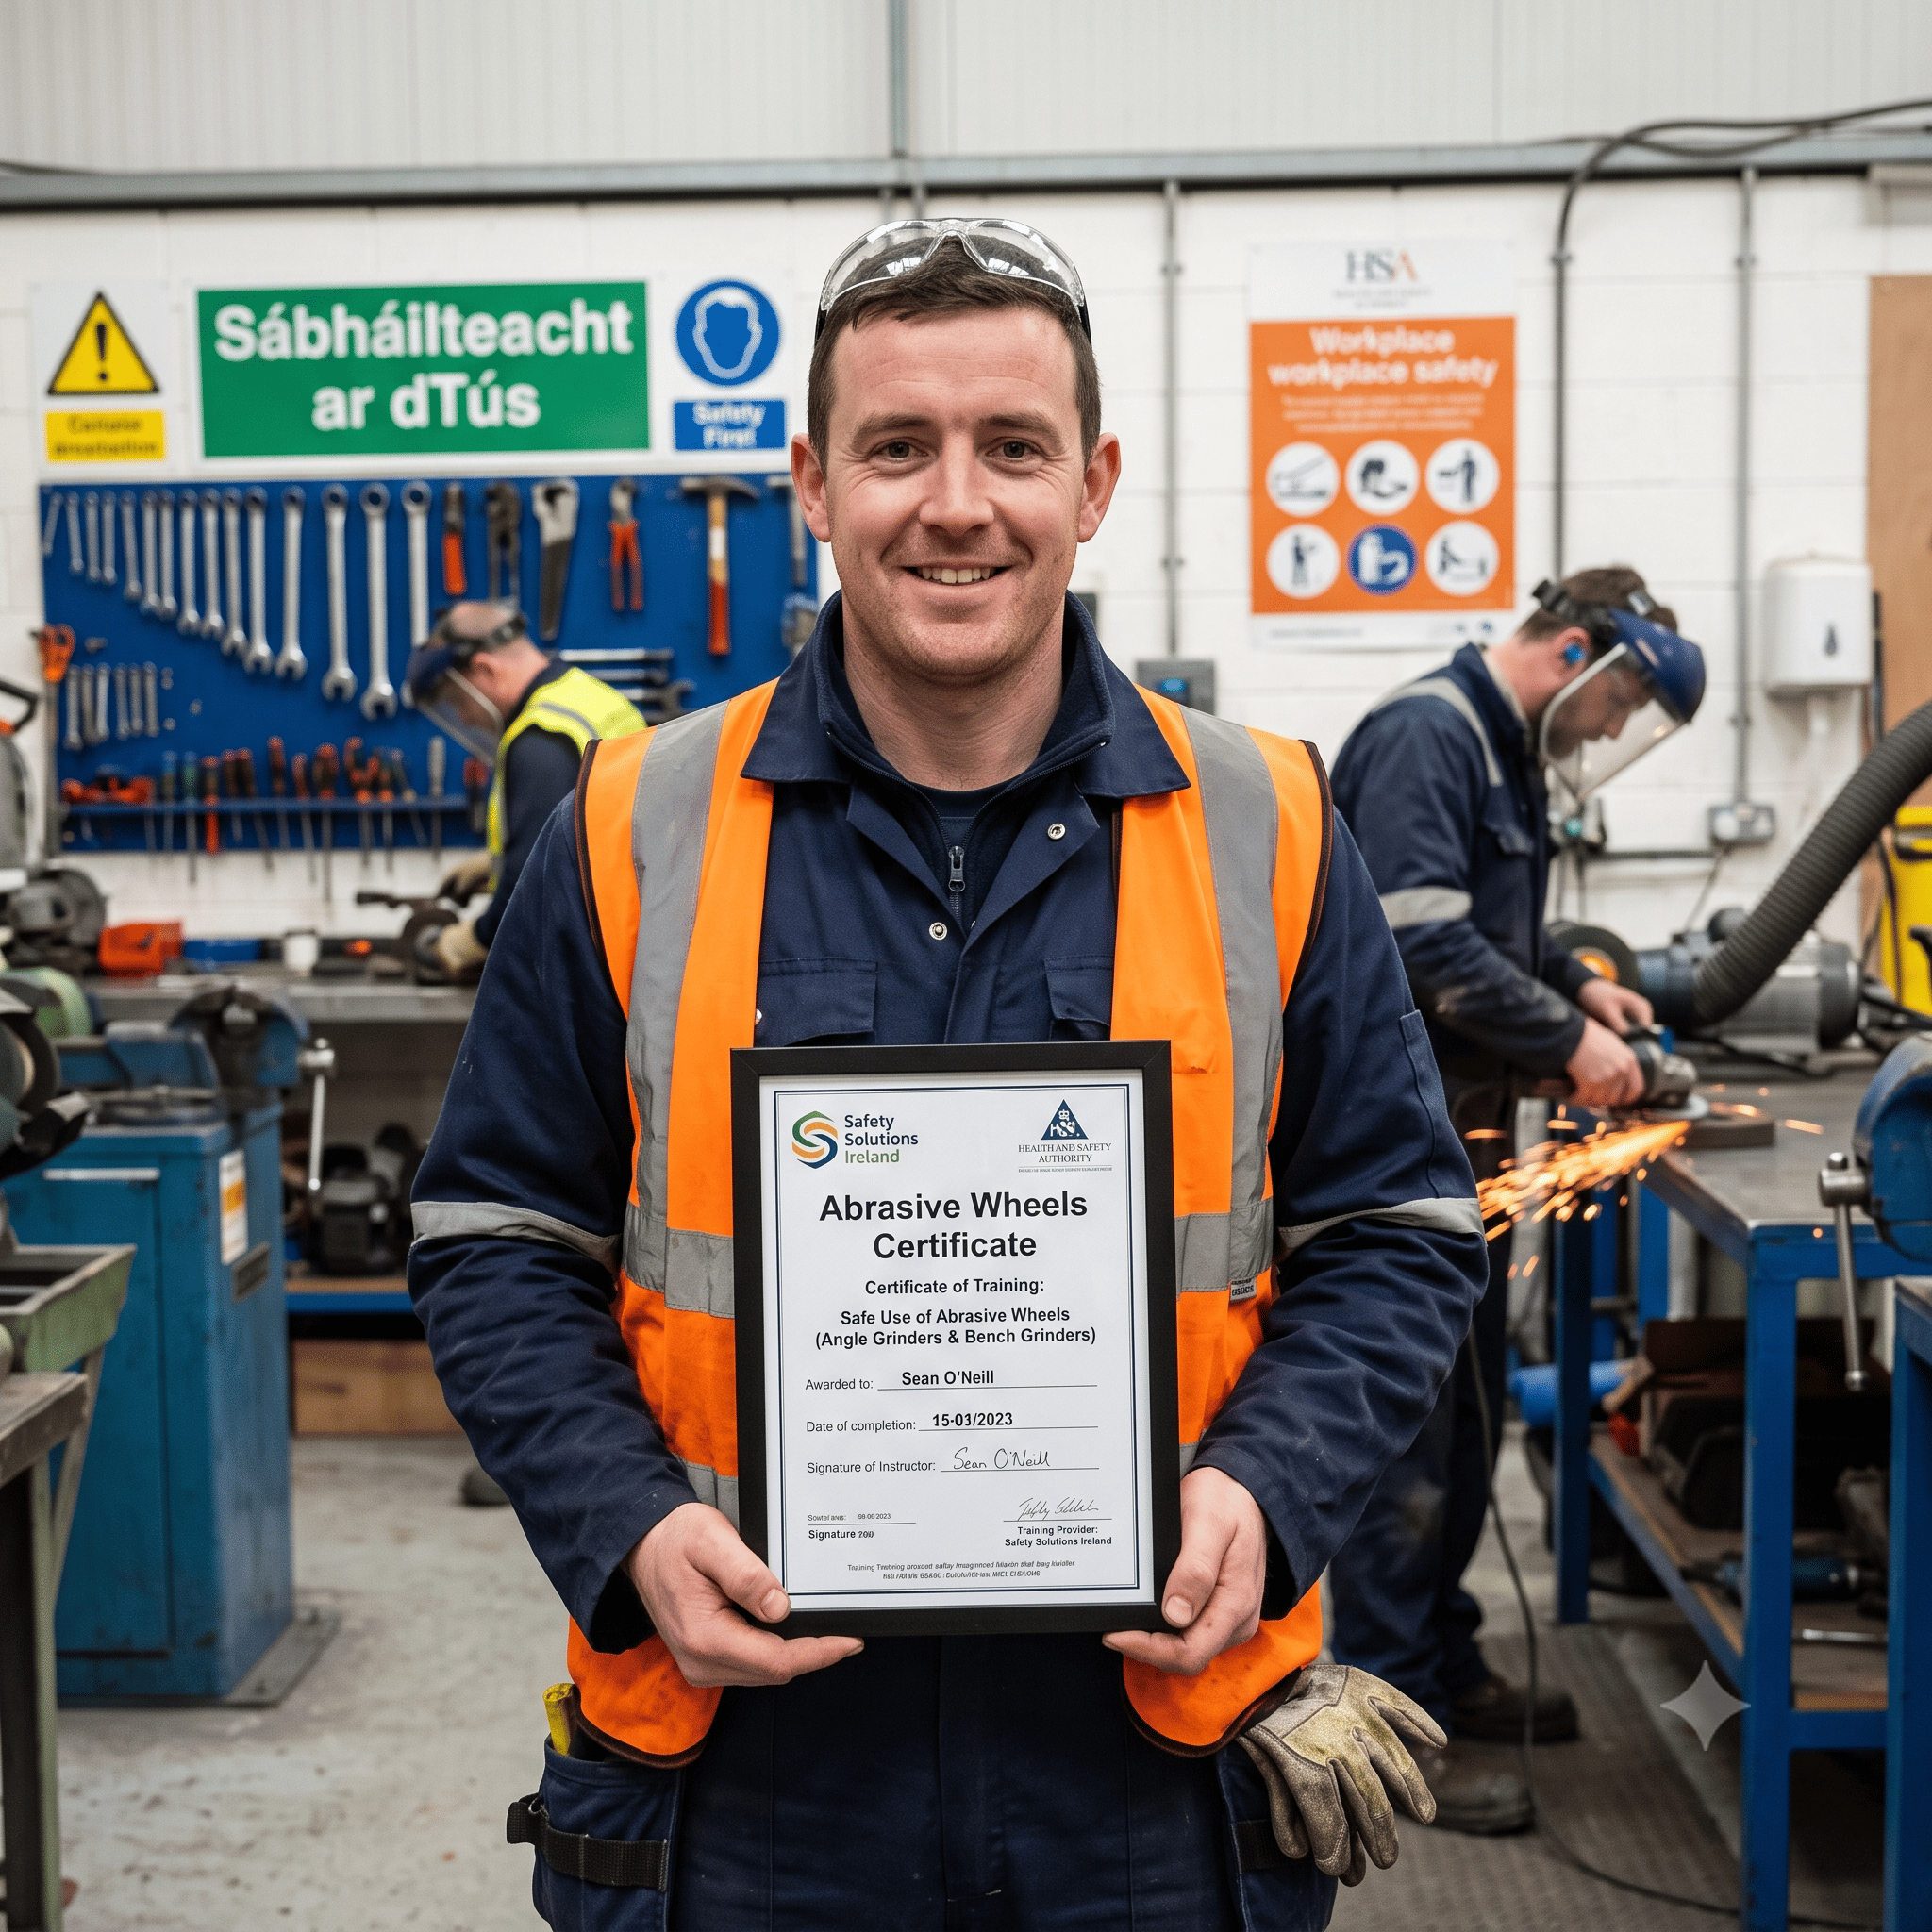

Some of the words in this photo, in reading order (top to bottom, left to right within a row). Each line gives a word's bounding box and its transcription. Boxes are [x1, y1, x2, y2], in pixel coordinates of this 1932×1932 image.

[1347, 250, 1418, 281] HSA
[214, 298, 634, 361] Sábháilteacht
[1310, 325, 1455, 358] Workplace
[1267, 357, 1409, 390] workplace
[1413, 354, 1499, 388] safety
[312, 385, 375, 431] ar
[390, 369, 541, 430] dTús
[694, 401, 765, 428] Safety
[845, 1114, 895, 1130] Safety
[845, 1132, 918, 1145] Solutions
[845, 1149, 899, 1163] Ireland
[1018, 1144, 1054, 1153] HEALTH
[1076, 1143, 1112, 1152] SAFETY
[820, 1193, 960, 1221] Abrasive
[971, 1191, 1087, 1218] Wheels
[874, 1232, 1036, 1258] Certificate
[866, 1280, 947, 1294] Certificate
[953, 1279, 969, 1292] of
[974, 1278, 1043, 1294] Training:
[841, 1310, 875, 1324] Safe
[881, 1310, 910, 1324] Use
[916, 1309, 932, 1324] of
[936, 1308, 1007, 1323] Abrasive
[1011, 1307, 1070, 1322] Wheels
[816, 1332, 867, 1350] (Angle
[874, 1331, 941, 1345] Grinders
[948, 1330, 958, 1343] &
[966, 1329, 1015, 1343] Bench
[1021, 1327, 1095, 1344] Grinders)
[806, 1379, 855, 1391] Awarded
[859, 1379, 873, 1389] to:
[902, 1372, 939, 1385] Sean
[944, 1370, 993, 1384] O'Neill
[807, 1422, 833, 1432] Date
[837, 1421, 847, 1431] of
[851, 1420, 915, 1433] completion:
[933, 1412, 1012, 1426] 15-03/2023
[953, 1446, 987, 1470] Sean
[993, 1447, 1050, 1469] O'Neill
[807, 1461, 861, 1474] Signature
[865, 1461, 875, 1472] of
[880, 1461, 935, 1471] Instructor:
[808, 1530, 856, 1541] Signature
[1018, 1526, 1054, 1536] Training
[1058, 1525, 1097, 1534] Provider:
[1006, 1539, 1033, 1548] Safety
